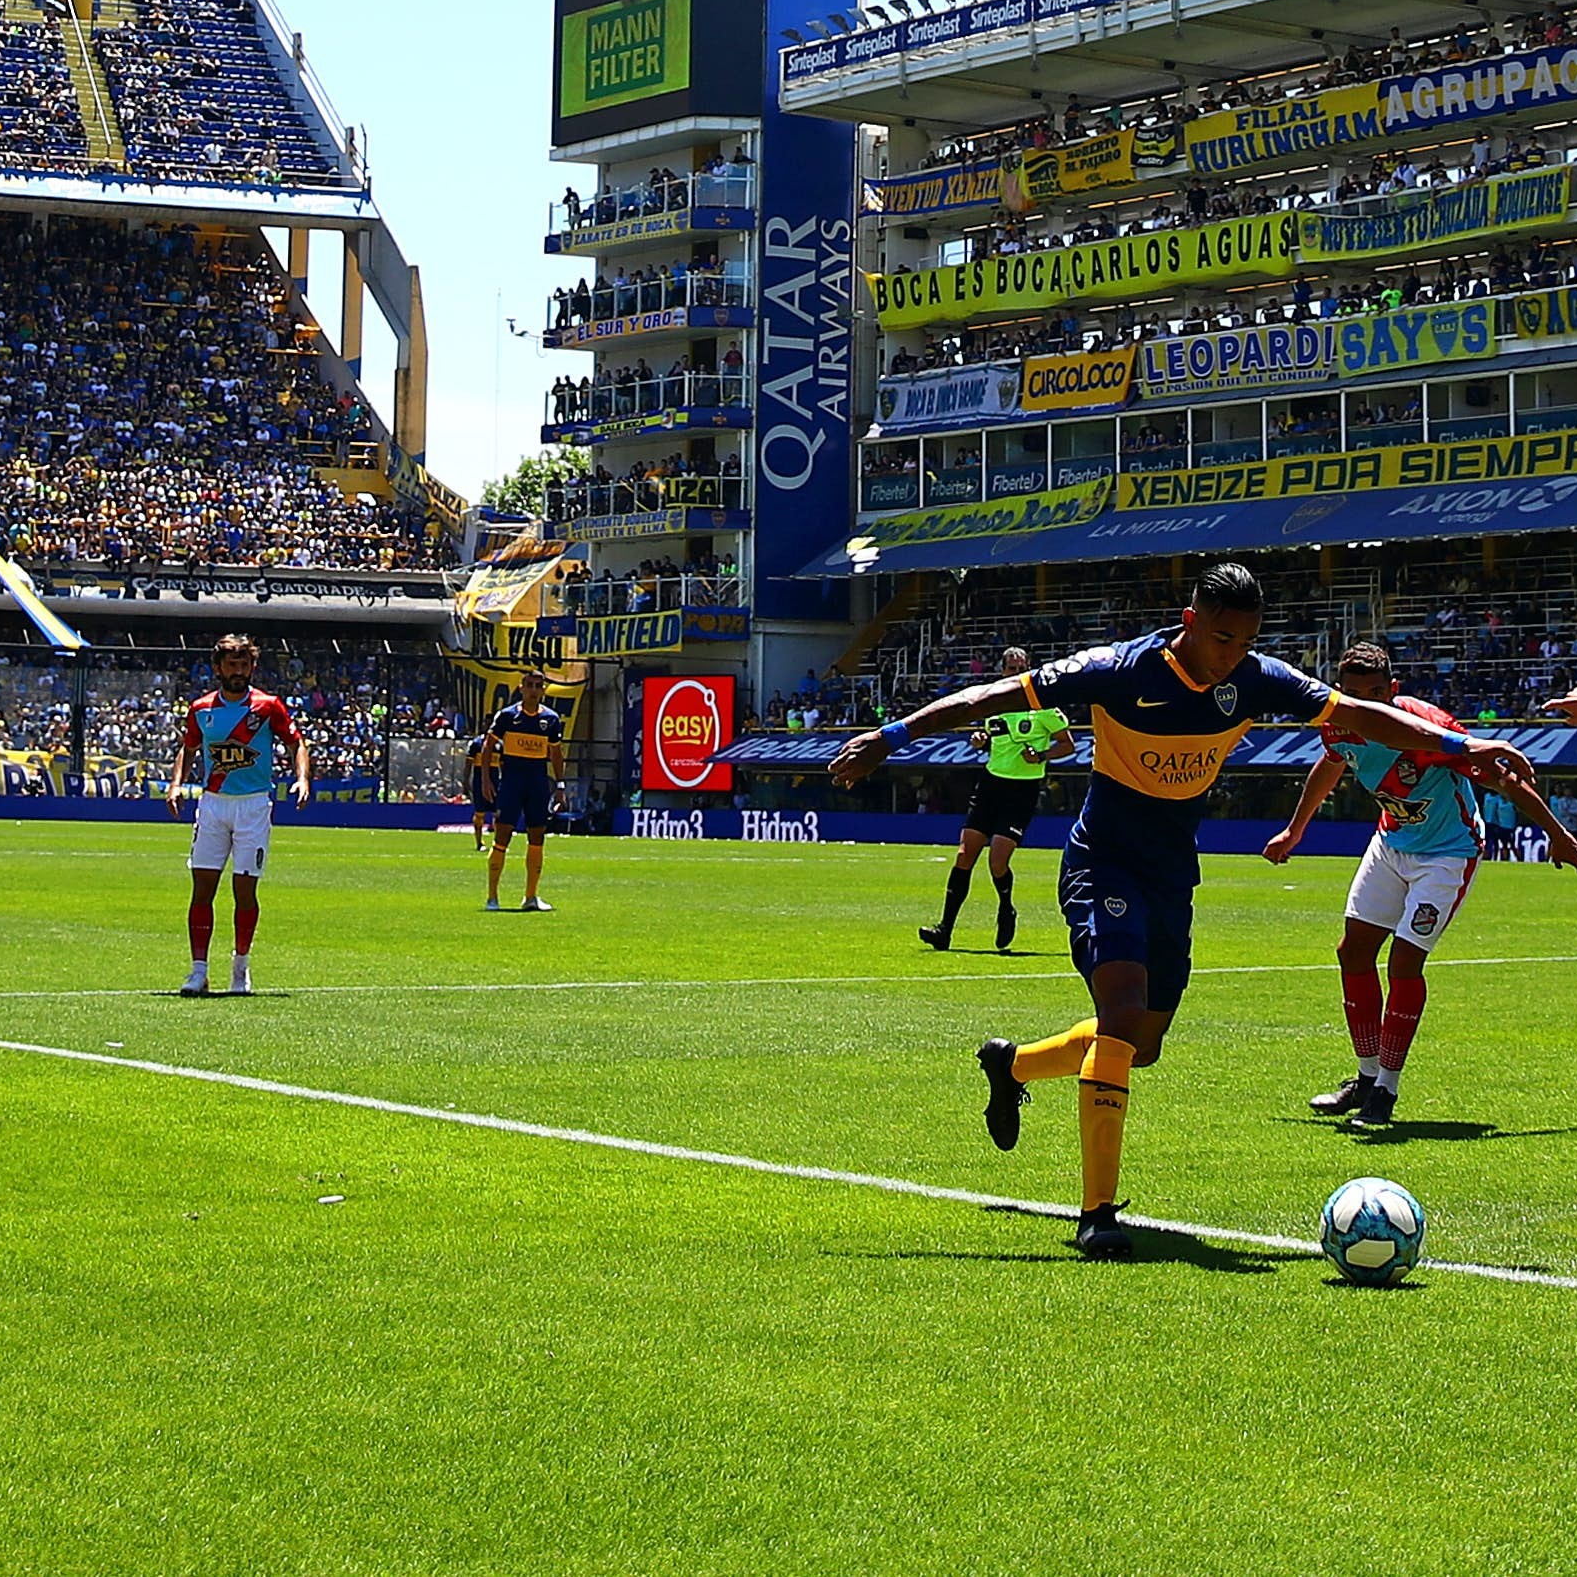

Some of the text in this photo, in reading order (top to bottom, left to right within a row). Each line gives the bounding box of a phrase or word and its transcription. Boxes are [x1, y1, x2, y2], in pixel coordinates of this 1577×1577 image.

[589, 6, 662, 55] MANN
[845, 28, 896, 60] Sinteplast
[907, 13, 961, 44] Sinteplast
[589, 41, 661, 90] FILTER
[787, 45, 836, 74] Sinteplast
[1235, 99, 1326, 131] FILIAL
[1190, 107, 1384, 173] HURLINGHAM
[876, 214, 1293, 312] BOCA ES BOCA CARLOS AGUAS
[577, 311, 672, 342] EL SUR Y ORO
[816, 218, 851, 422] AIRWAYS
[760, 215, 826, 490] QATAR
[1144, 326, 1333, 383] LEOPARDI
[1028, 361, 1126, 398] CIRCOLOCO
[870, 482, 909, 501] Fibertel
[992, 473, 1036, 493] Fibertel
[1127, 466, 1269, 507] XENEIZE
[1280, 453, 1381, 495] POR
[1388, 487, 1525, 517] AXION
[1088, 524, 1122, 538] LA
[1127, 519, 1192, 536] MITAD
[577, 613, 681, 654] BANFIELD
[661, 713, 714, 740] easy
[221, 748, 245, 763] LN
[1139, 748, 1218, 772] QATAR
[1253, 732, 1321, 765] LA
[631, 808, 704, 841] Hidro3
[741, 810, 819, 843] Hidro3
